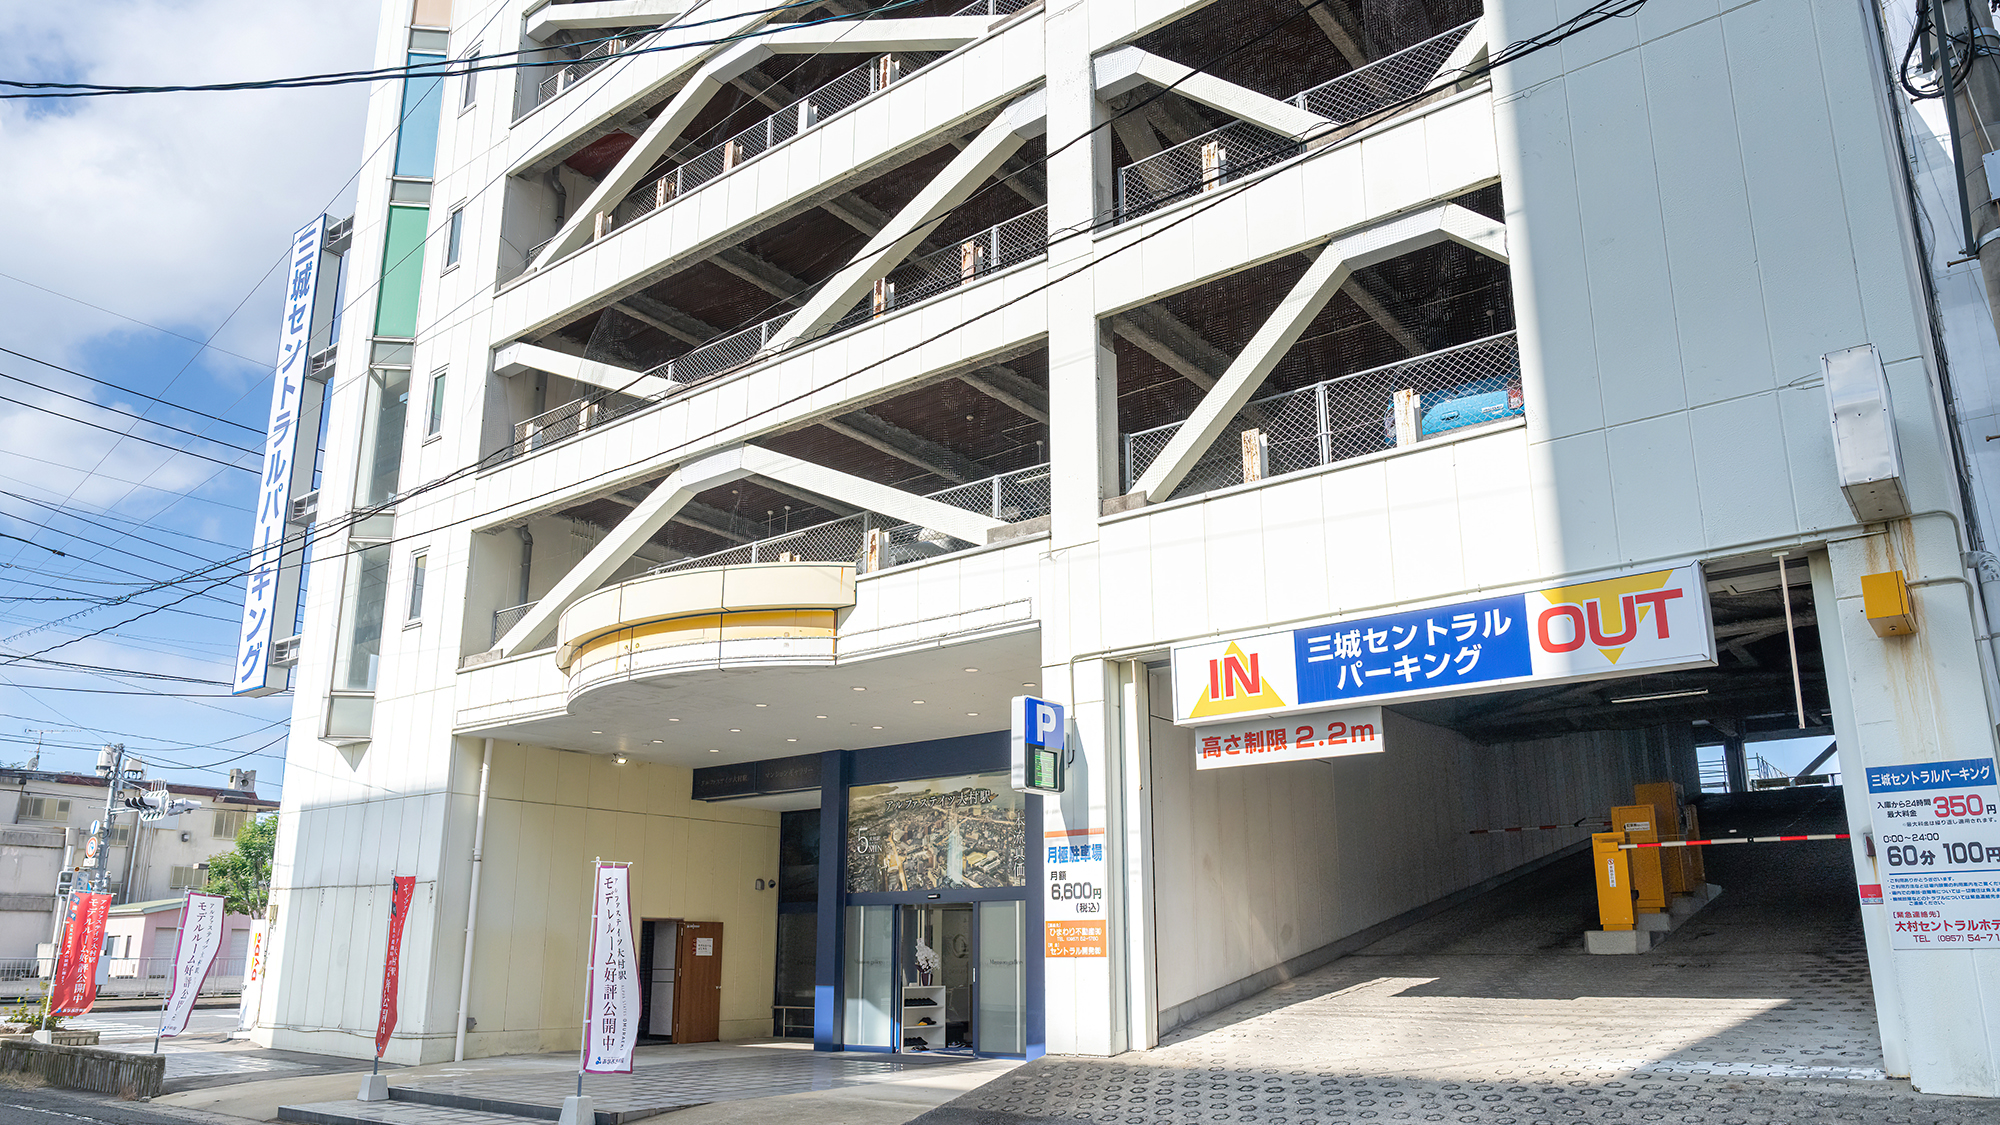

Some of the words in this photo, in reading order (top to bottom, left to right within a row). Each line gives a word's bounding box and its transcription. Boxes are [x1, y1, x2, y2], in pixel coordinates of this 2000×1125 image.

[241, 226, 317, 683] 三城セントラルパーキング
[1308, 609, 1511, 663] 三城セントラル
[1538, 588, 1683, 653] OUT
[1209, 653, 1260, 699] IN
[1337, 643, 1482, 690] パーキング
[1036, 703, 1056, 742] P
[1202, 728, 1287, 759] 高さ制限
[1295, 721, 1375, 749] 2.2m
[1871, 765, 1990, 787] 三城セントラルパーキング
[1887, 810, 1917, 818] 最大料金
[857, 827, 868, 853] 5
[1047, 843, 1102, 864] 月極駐車場
[1887, 845, 1936, 866] 60分
[1943, 842, 2000, 864] 100円
[1050, 870, 1066, 881] 月額
[1051, 882, 1102, 901] 6,600円
[73, 898, 99, 1003] モデルルーム好評公開中
[1913, 935, 1930, 943] TEL
